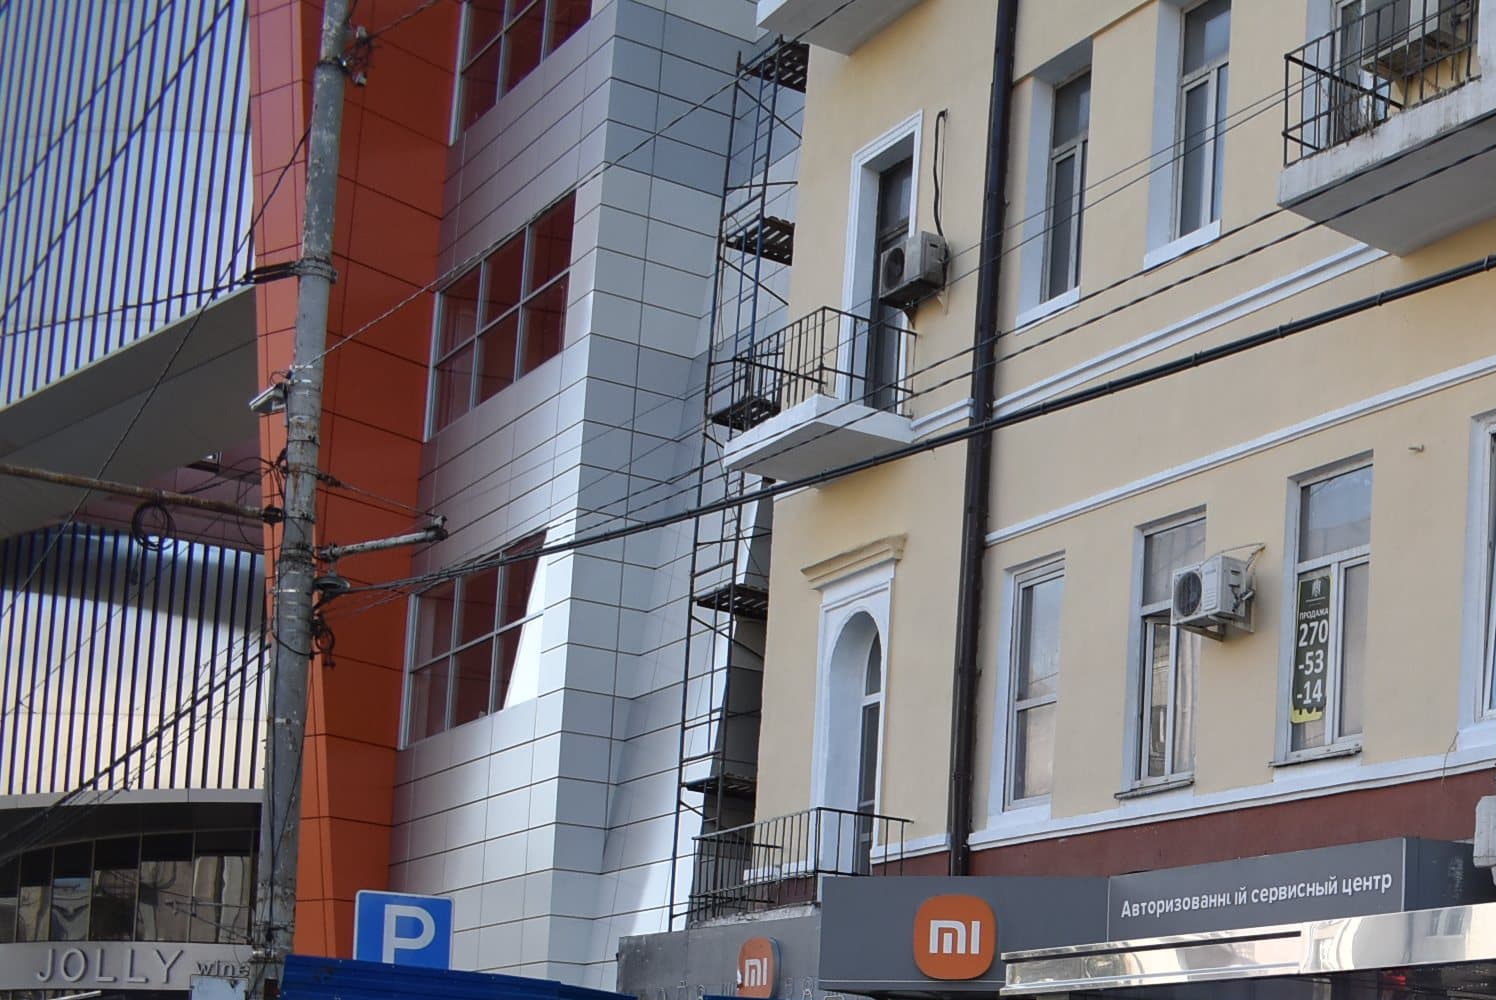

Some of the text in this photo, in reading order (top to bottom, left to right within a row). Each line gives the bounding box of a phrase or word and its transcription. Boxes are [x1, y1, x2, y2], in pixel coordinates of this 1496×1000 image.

[1298, 620, 1329, 647] 270
[1298, 650, 1324, 676] -53
[1297, 679, 1323, 705] -14
[1251, 876, 1338, 907] сервисный
[1342, 872, 1393, 896] центр
[382, 904, 436, 966] P
[36, 948, 251, 984] JOLLY wine
